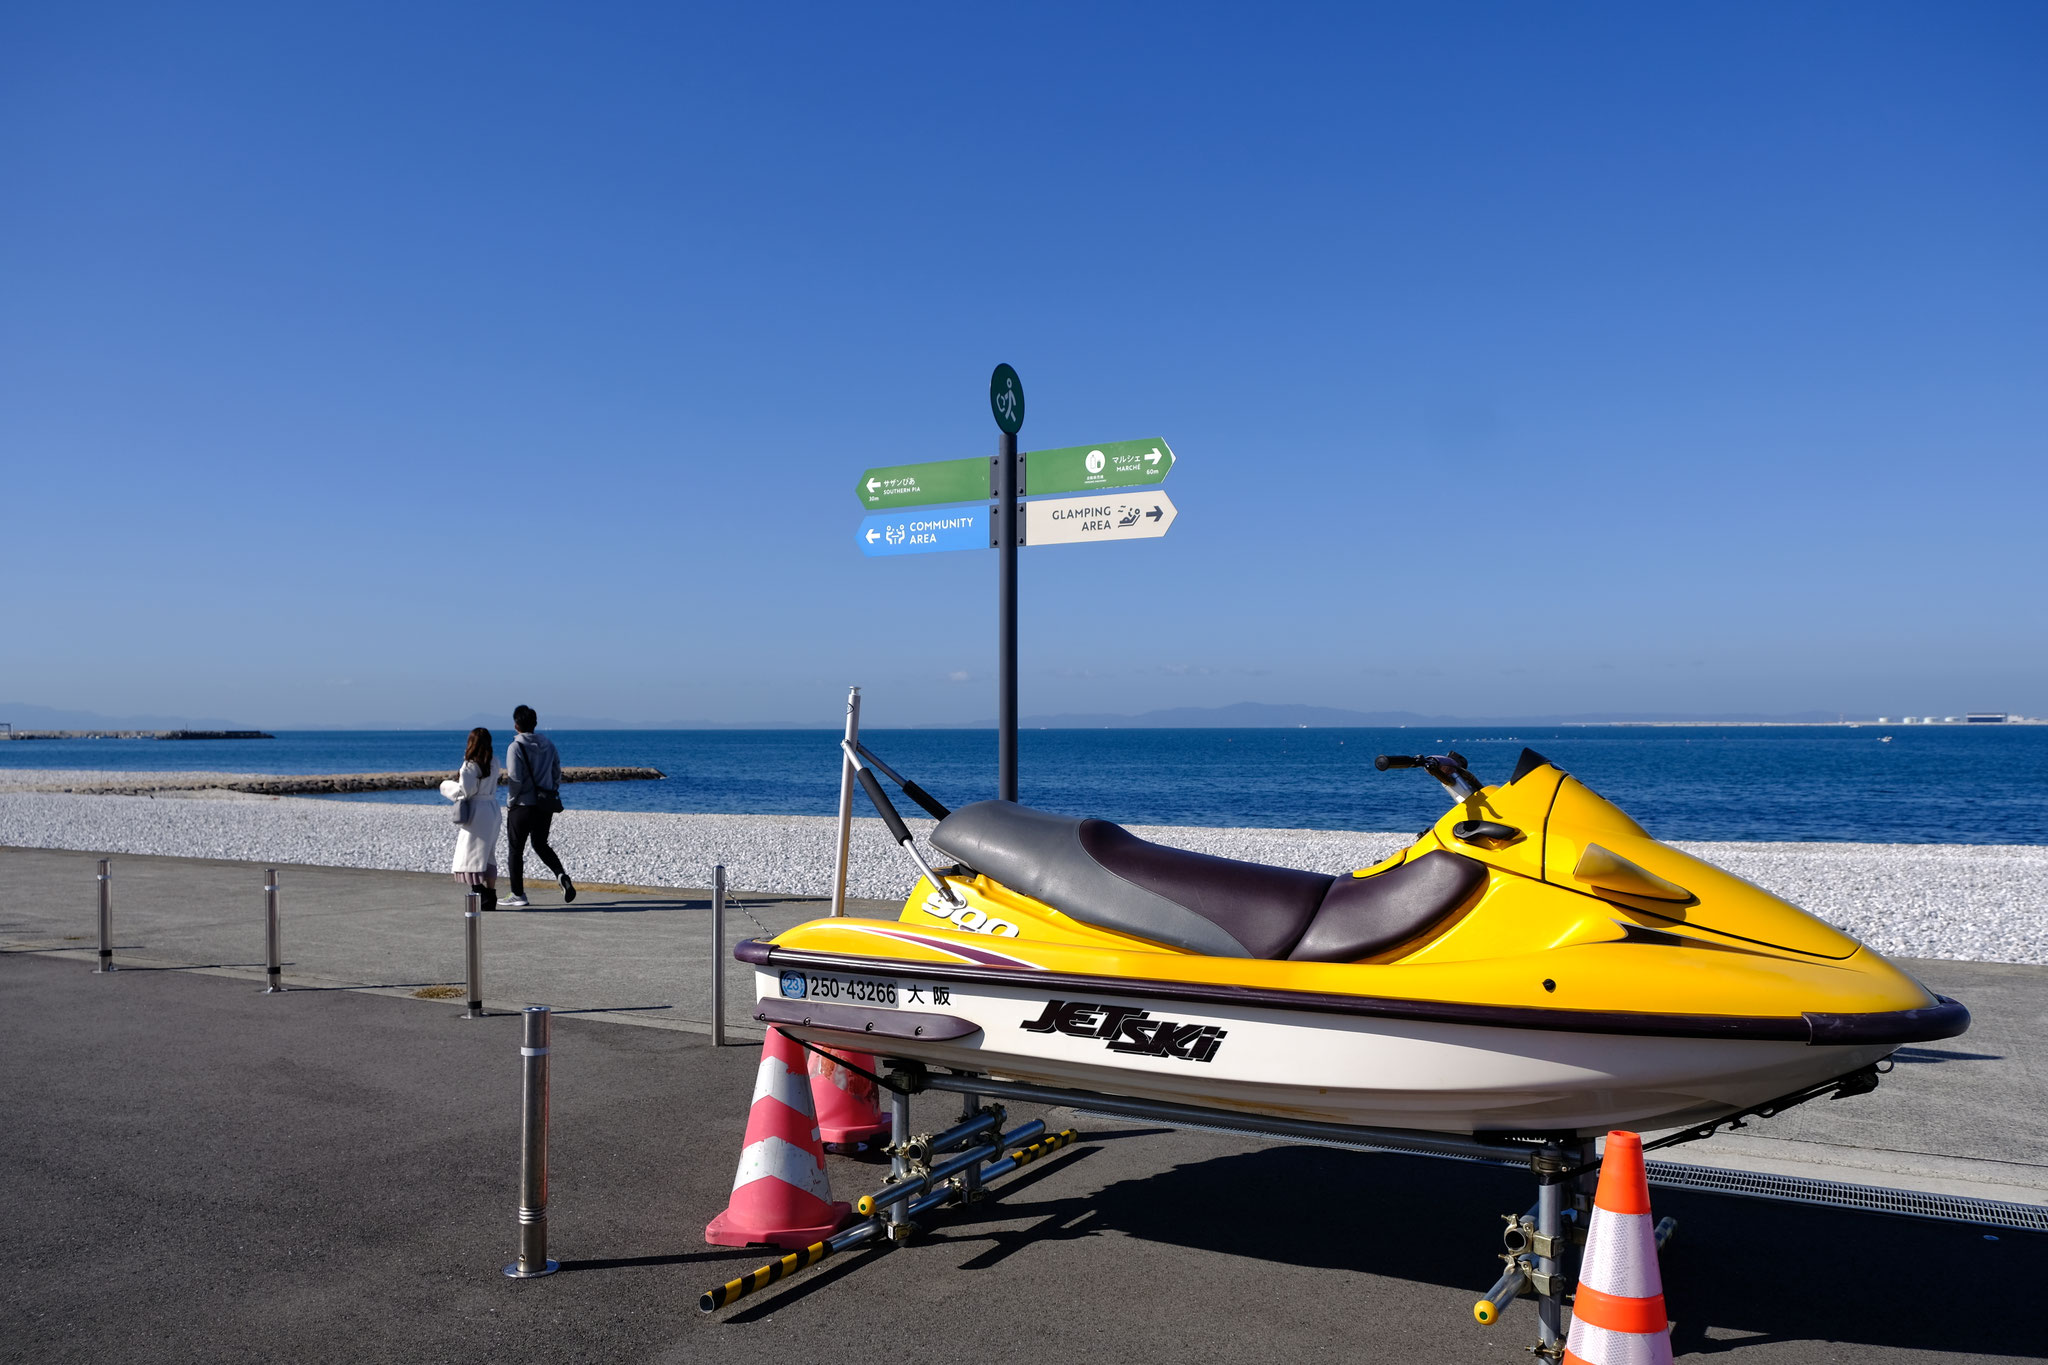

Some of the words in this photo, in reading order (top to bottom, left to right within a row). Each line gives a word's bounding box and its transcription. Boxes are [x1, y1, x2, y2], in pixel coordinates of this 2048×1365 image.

[1052, 506, 1111, 520] GLAMPING
[910, 517, 973, 531] COMMUNITY
[1081, 520, 1111, 531] AREA
[910, 534, 937, 544] AREA
[810, 976, 897, 1005] 250-43266
